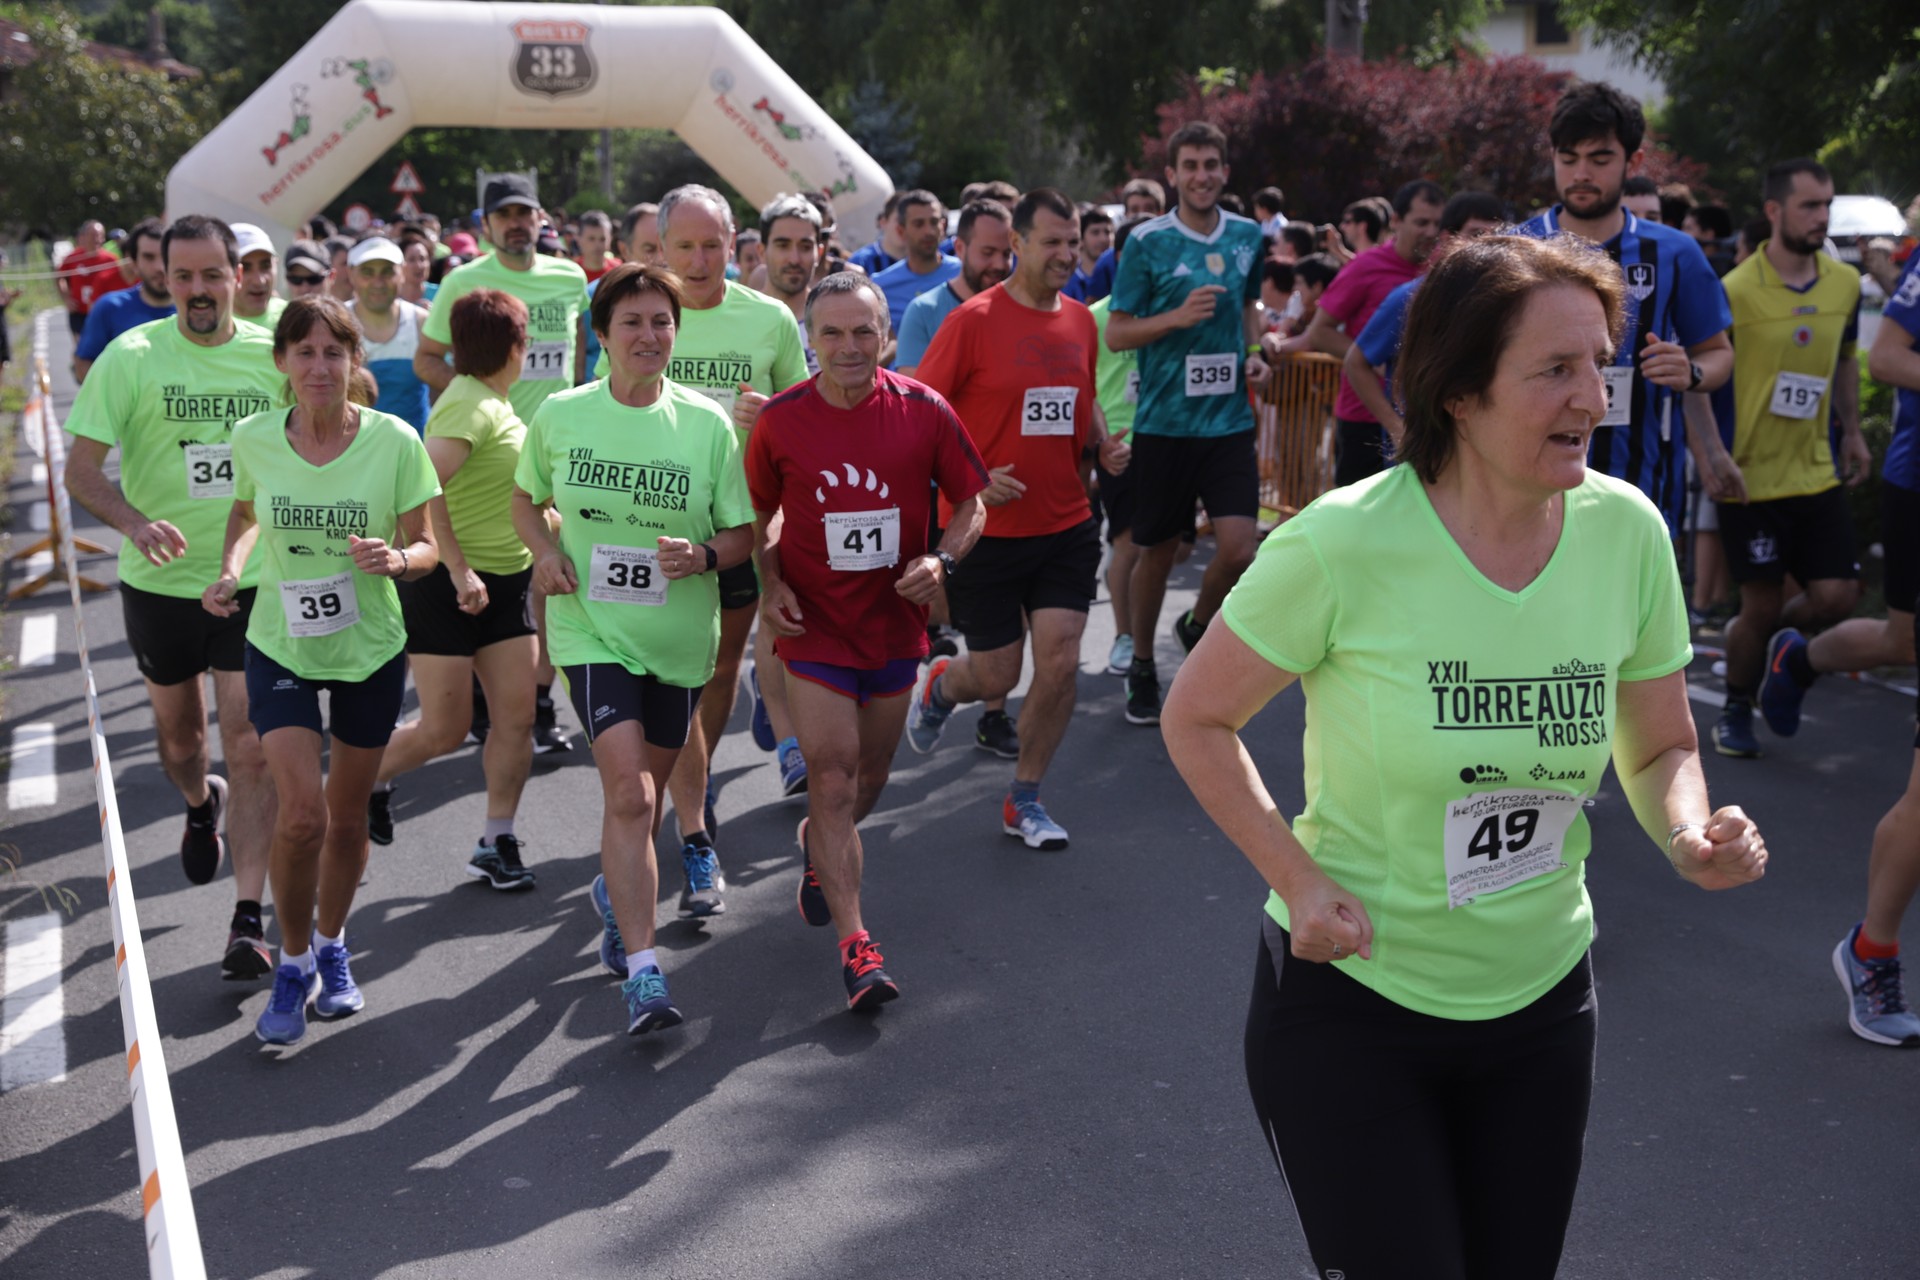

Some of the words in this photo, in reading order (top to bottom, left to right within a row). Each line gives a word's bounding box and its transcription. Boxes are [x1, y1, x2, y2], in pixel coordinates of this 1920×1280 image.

[530, 45, 577, 78] 33
[527, 351, 563, 369] 111
[1190, 365, 1231, 384] 339
[1027, 400, 1072, 421] 330
[1780, 386, 1821, 411] 197
[193, 459, 234, 484] 34
[567, 460, 690, 497] TORREAUZO
[632, 490, 687, 513] KROSSA
[272, 507, 368, 528] TORREAUZO
[639, 519, 666, 530] LANA
[843, 527, 883, 554] 41
[607, 562, 652, 589] 38
[300, 592, 342, 620] 39
[1427, 660, 1474, 684] XXII.
[1432, 679, 1606, 724] TORREAUZO
[1538, 719, 1608, 748] KROSSA
[1548, 769, 1586, 781] LANA
[1452, 793, 1577, 818] herrikrosa.eus
[1467, 808, 1540, 862] 49
